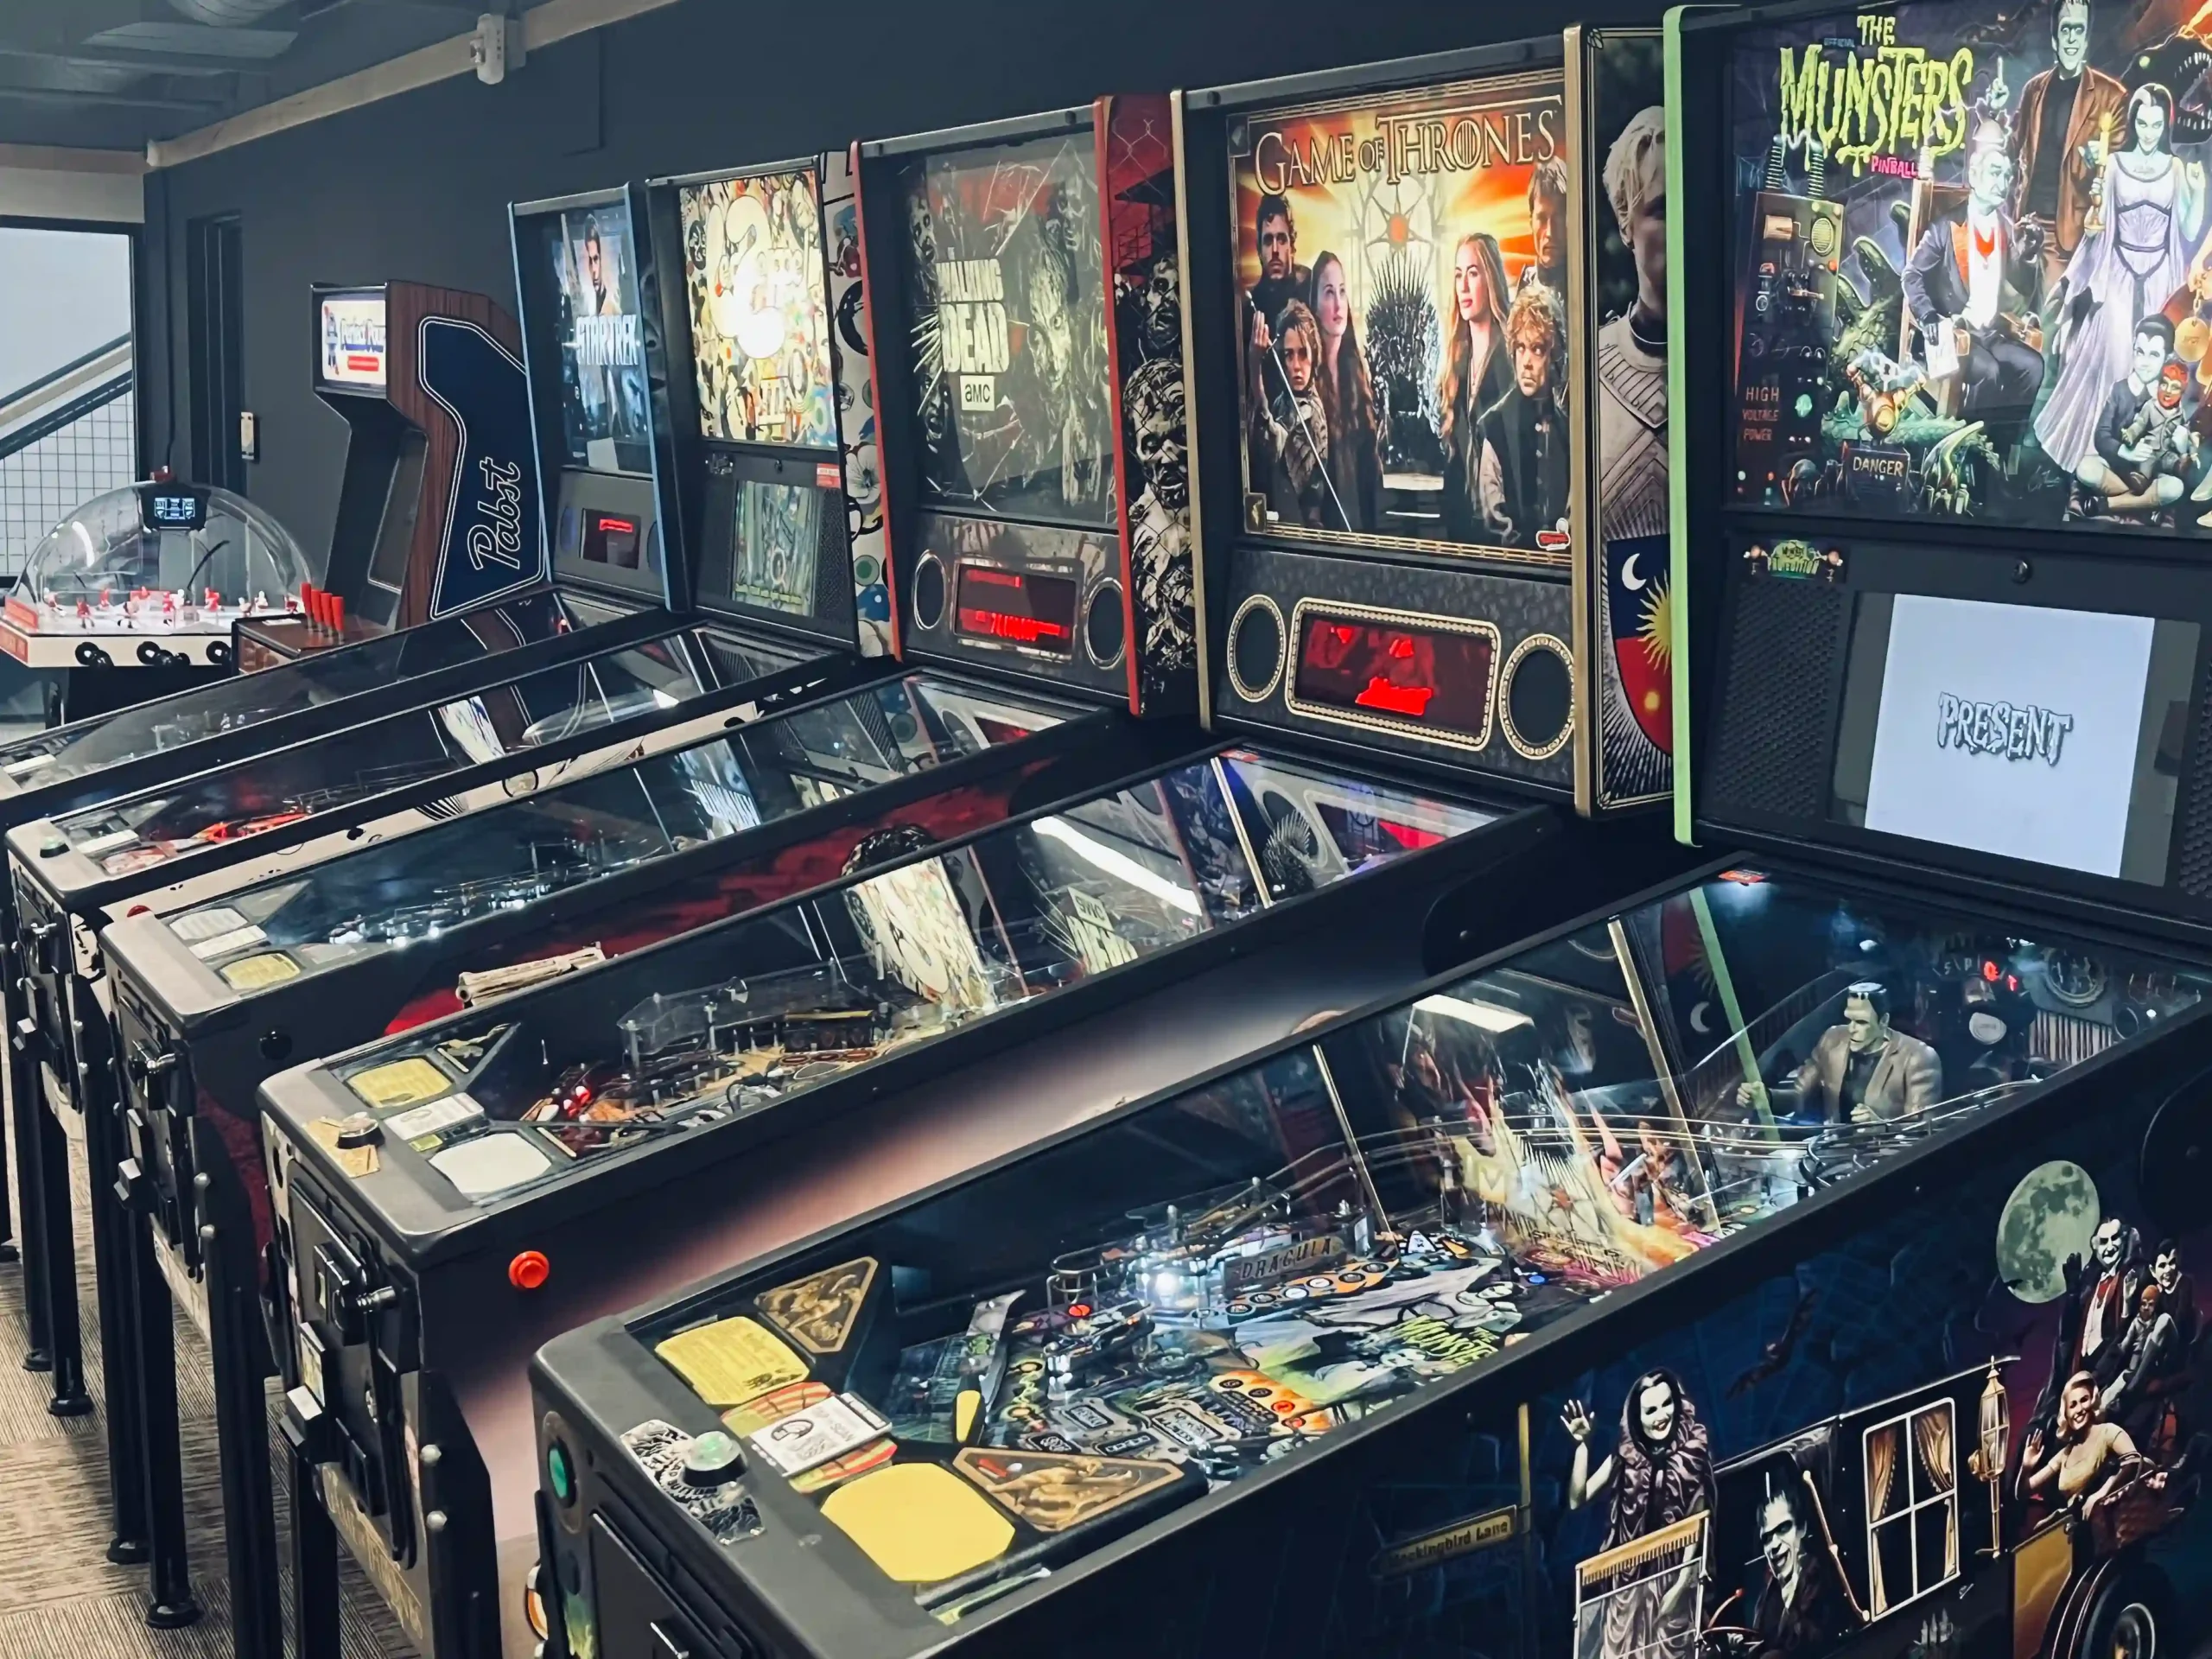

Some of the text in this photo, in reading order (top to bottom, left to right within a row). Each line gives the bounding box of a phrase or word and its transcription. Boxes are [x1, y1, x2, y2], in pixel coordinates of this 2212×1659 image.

[1857, 15, 1896, 46] THE
[1780, 44, 1974, 178] MUNSTERS
[1254, 93, 1562, 196] GAME OF THRONES
[1871, 156, 1920, 179] PINBALL
[936, 258, 1004, 302] WALKING
[575, 314, 639, 365] STAR TREK
[938, 302, 1010, 373] DEAD
[1745, 385, 1780, 402] HIGH
[1743, 428, 1773, 442] POWER
[1853, 455, 1904, 477] DANGER
[467, 455, 521, 570] Pabst
[1936, 691, 2075, 767] PRESENT
[1239, 1237, 1332, 1281] DRACULA
